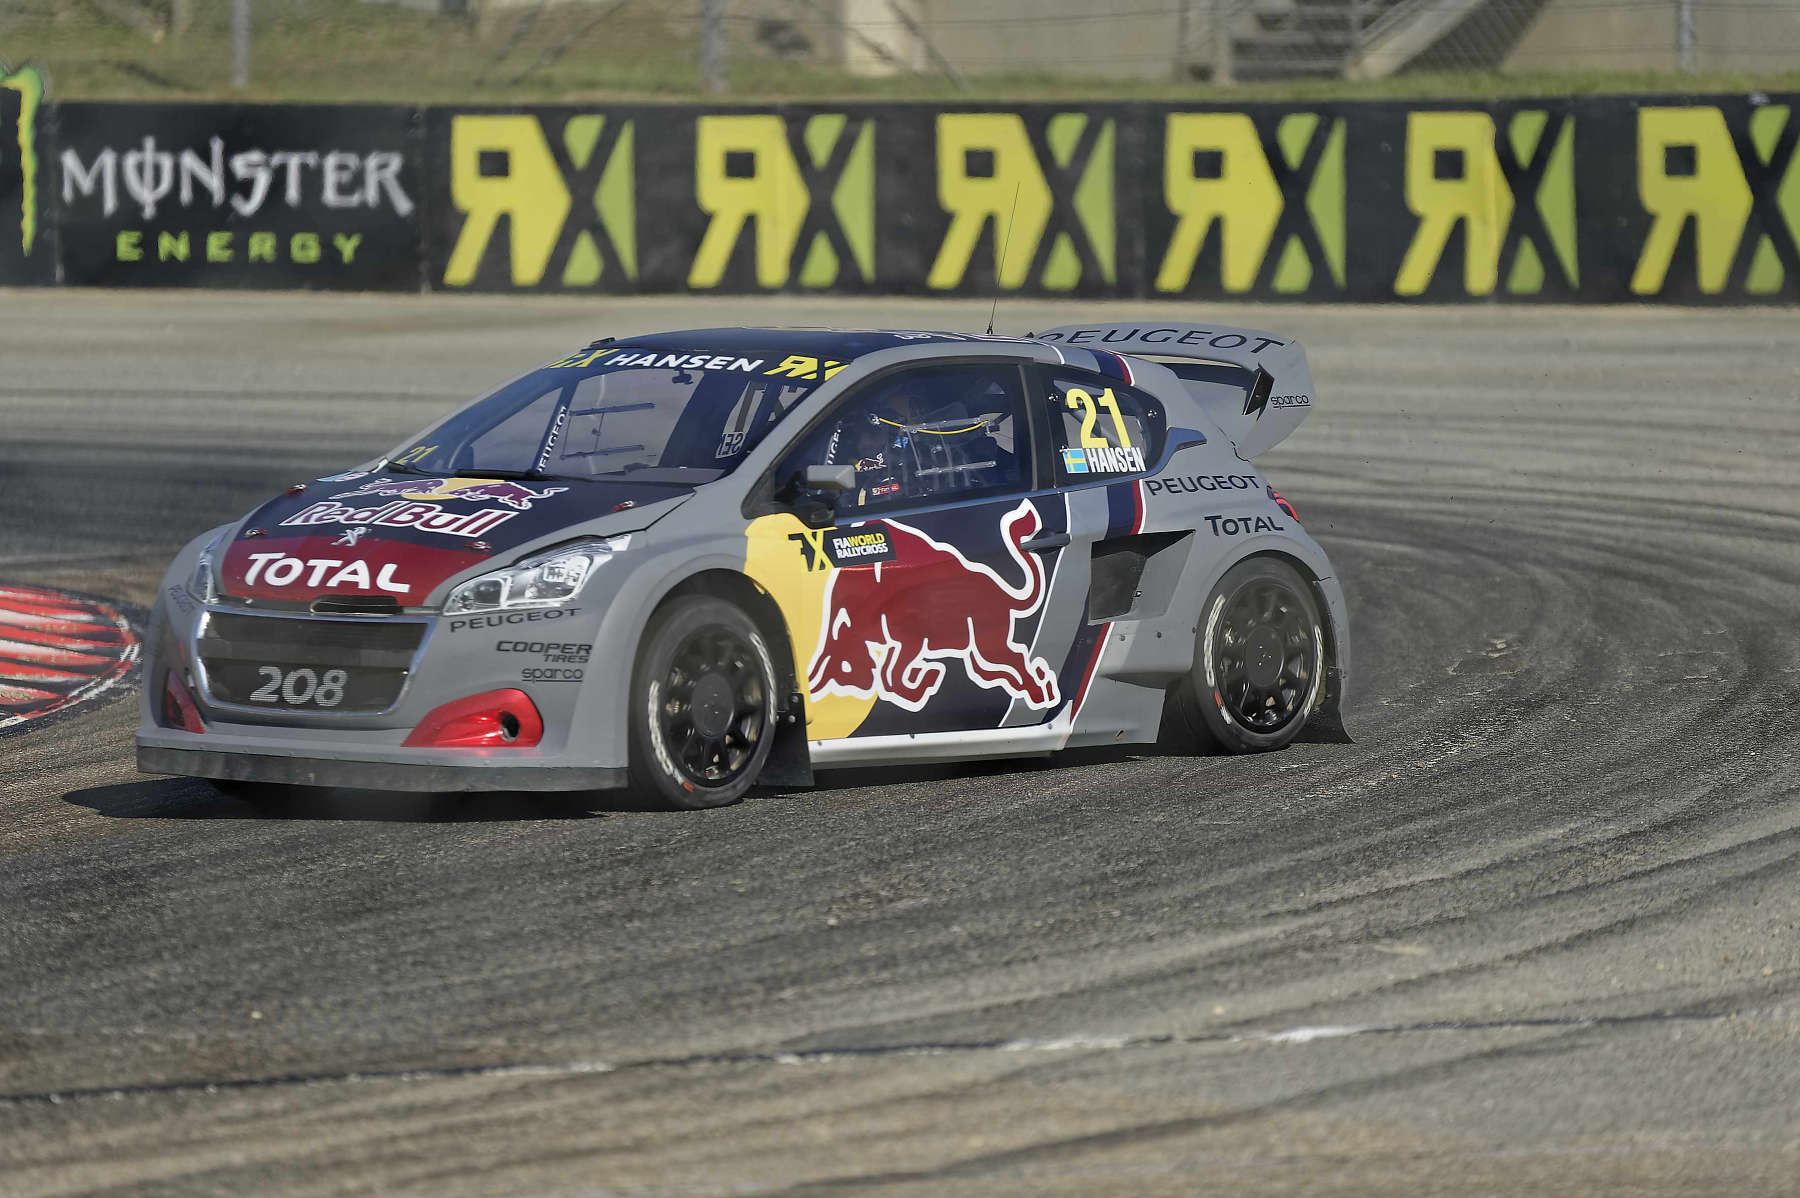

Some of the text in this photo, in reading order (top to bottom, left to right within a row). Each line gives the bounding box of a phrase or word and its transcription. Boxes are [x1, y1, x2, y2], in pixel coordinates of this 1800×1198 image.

[61, 135, 414, 220] MONSTER
[443, 114, 639, 287] RX
[687, 113, 876, 288] RX
[926, 112, 1117, 290] RX
[1154, 111, 1346, 293] RX
[1394, 110, 1580, 295] RX
[116, 230, 363, 264] ENERGY
[603, 352, 765, 373] HANSEN
[1270, 394, 1311, 410] sparco
[1065, 387, 1132, 449] 21
[1088, 447, 1147, 473] HANSEN
[1144, 474, 1257, 496] PEUGEOT
[1204, 514, 1285, 537] TOTAL
[835, 543, 889, 559] RALLYCROSS
[244, 552, 411, 593] TOTAL
[450, 607, 583, 633] PEUGEOT
[496, 640, 593, 655] COOPER
[543, 653, 589, 664] TIRES
[249, 665, 348, 707] 208
[521, 667, 584, 683] sparco
